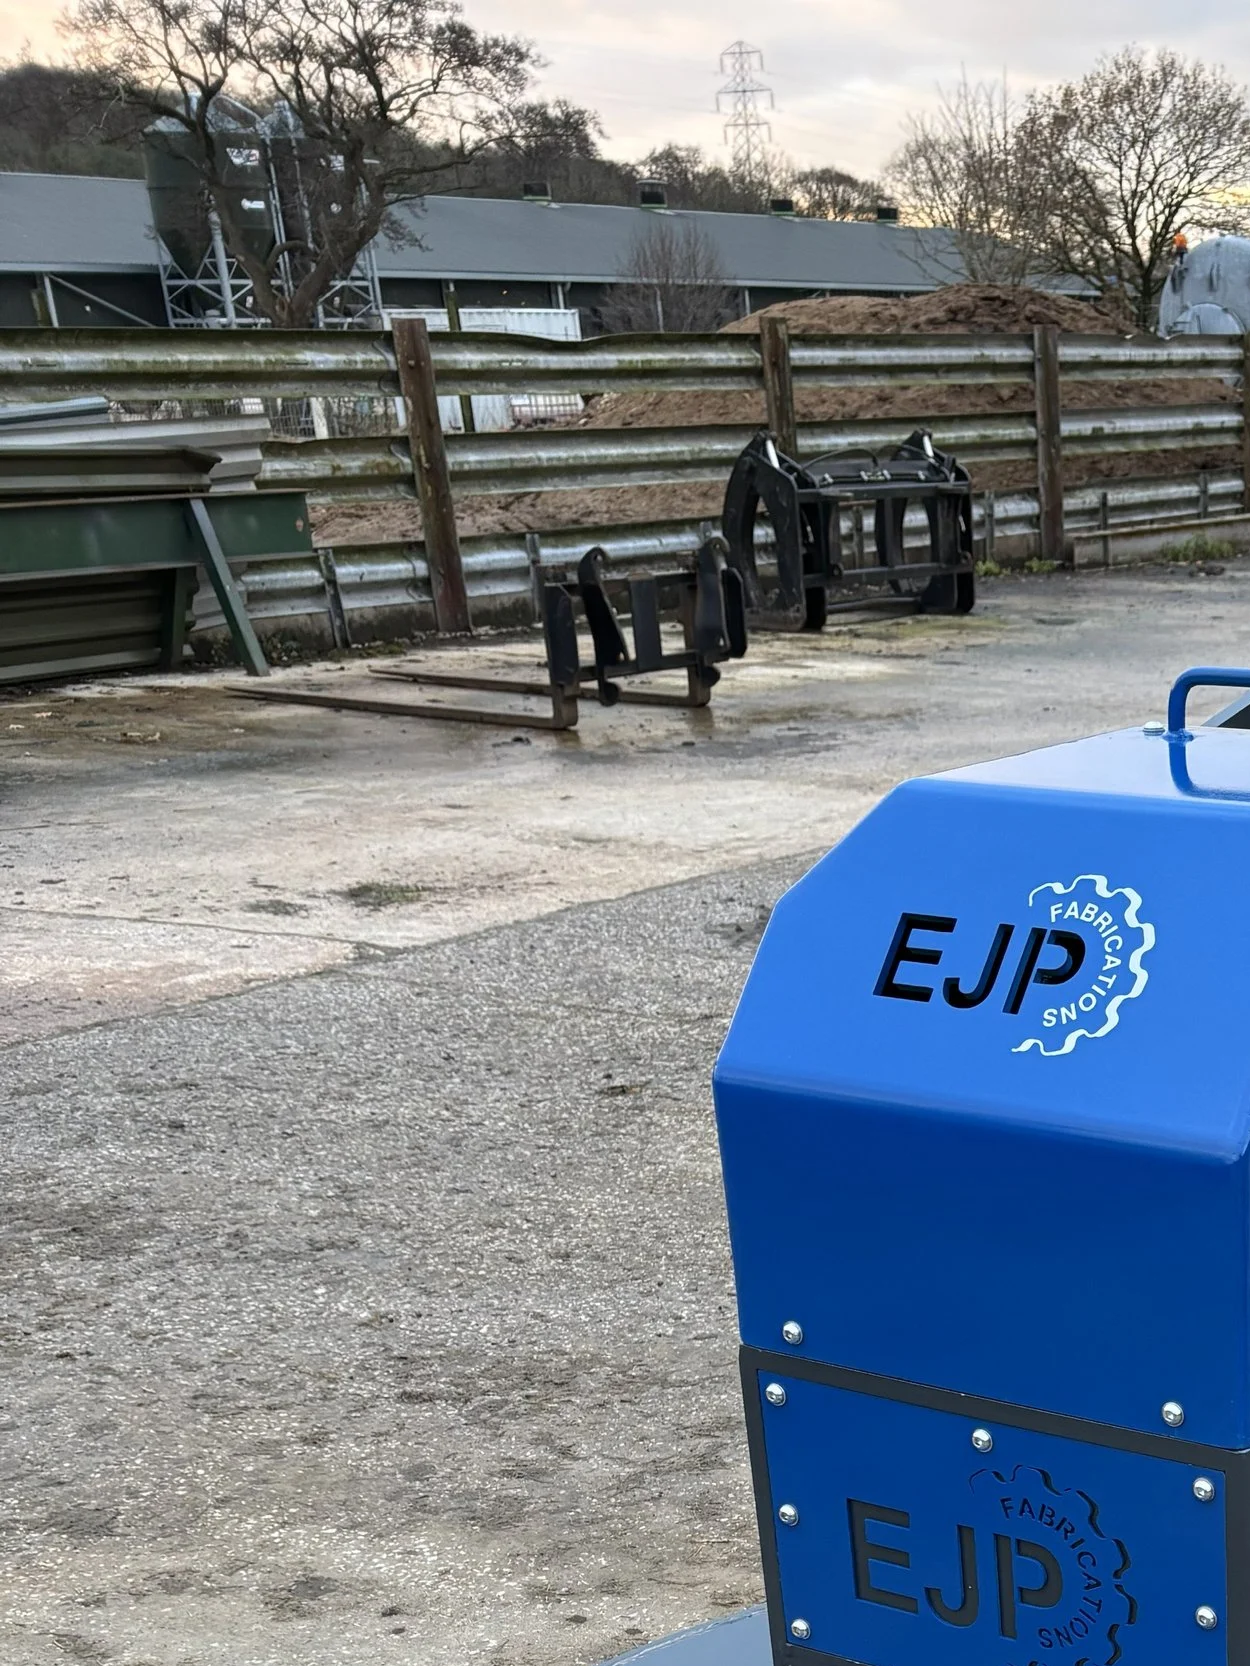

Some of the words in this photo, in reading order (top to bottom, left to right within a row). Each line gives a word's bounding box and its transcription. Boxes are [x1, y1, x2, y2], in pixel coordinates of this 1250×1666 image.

[873, 912, 1086, 1015] EJP
[1042, 900, 1123, 1028] FABRICATIONS
[846, 1497, 1063, 1640] EJP
[1000, 1496, 1103, 1651] FABRICATIONS
